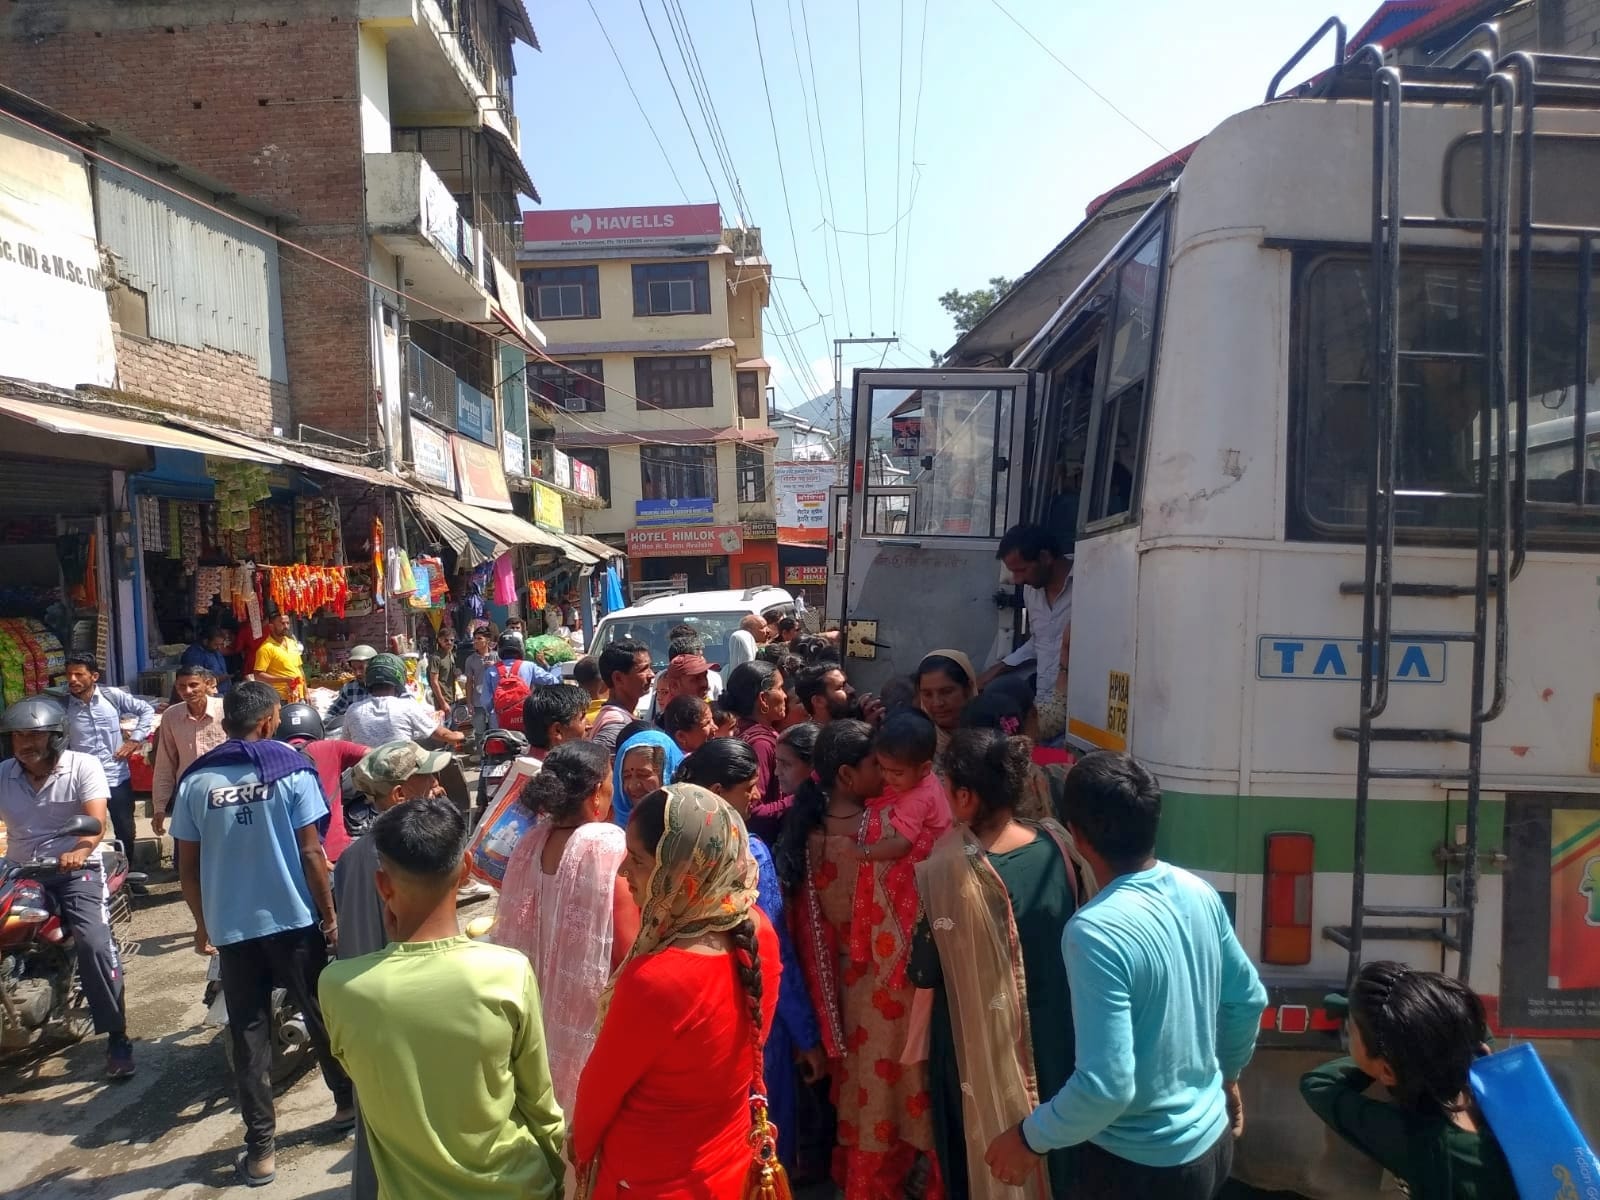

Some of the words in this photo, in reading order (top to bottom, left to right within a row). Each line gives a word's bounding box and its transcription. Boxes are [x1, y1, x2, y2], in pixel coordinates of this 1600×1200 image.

[596, 214, 675, 230] HAVELLS
[41, 254, 51, 275] &
[52, 255, 86, 287] M.Sc.
[630, 532, 667, 542] HOTEL
[672, 530, 716, 541] HIMLOK
[687, 541, 714, 549] Available
[1108, 706, 1128, 734] 6178
[211, 783, 269, 807] हटसन
[235, 805, 253, 825] घी
[1573, 1146, 1592, 1184] Indian
